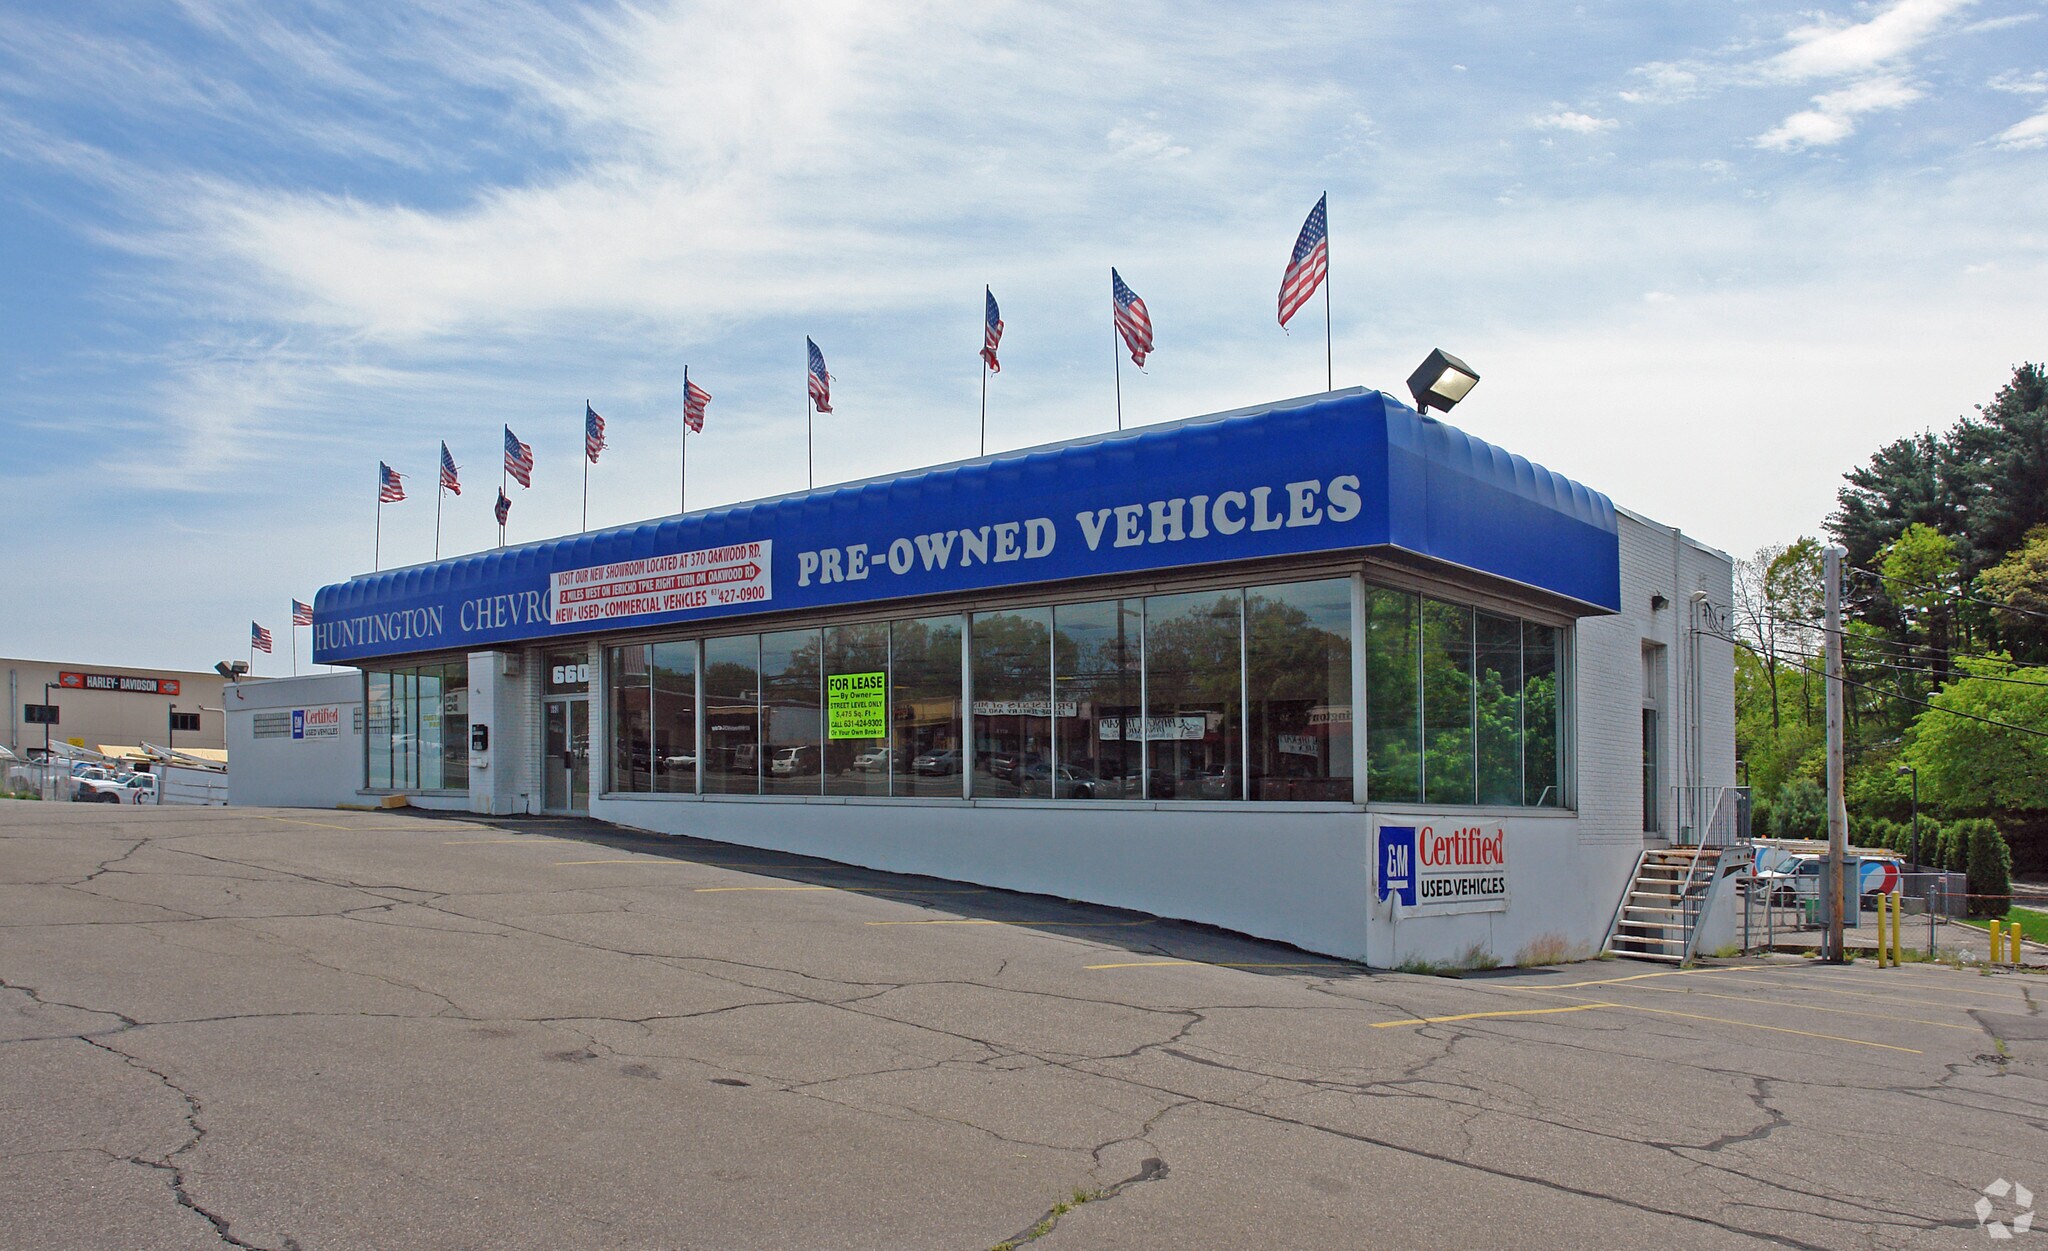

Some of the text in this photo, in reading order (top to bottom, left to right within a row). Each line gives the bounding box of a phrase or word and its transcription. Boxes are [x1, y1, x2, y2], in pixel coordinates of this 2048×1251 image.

[797, 475, 1362, 587] PRE-OWNED VEHICLES
[558, 543, 761, 586] VISIT OUR NEW SHOWROOM LOCATED AT 370 OAKWOOD RD.
[561, 565, 755, 604] 2 MILES WEST ON JERICHO TPKE RIGHT TURN ON OAKWOOD RD
[555, 607, 574, 622] NEW
[578, 603, 600, 620] USED
[605, 597, 662, 616] COMMERCIAL
[663, 590, 707, 610] VEHICLES
[719, 585, 765, 603] 427-0900
[315, 605, 444, 651] HUNTINGTON
[553, 664, 589, 684] 660
[830, 676, 883, 690] FOR LEASE
[830, 700, 883, 709] STREET LEVEL ONLY
[840, 692, 848, 700] By
[305, 708, 338, 725] Certified
[843, 718, 883, 728] 631-424-9302
[853, 710, 863, 718] Sq.
[305, 728, 317, 736] USED
[318, 727, 338, 736] VEHICLES
[1419, 826, 1504, 867] Certified
[1387, 843, 1409, 877] GM
[1421, 877, 1505, 897] USED VEHICLES
